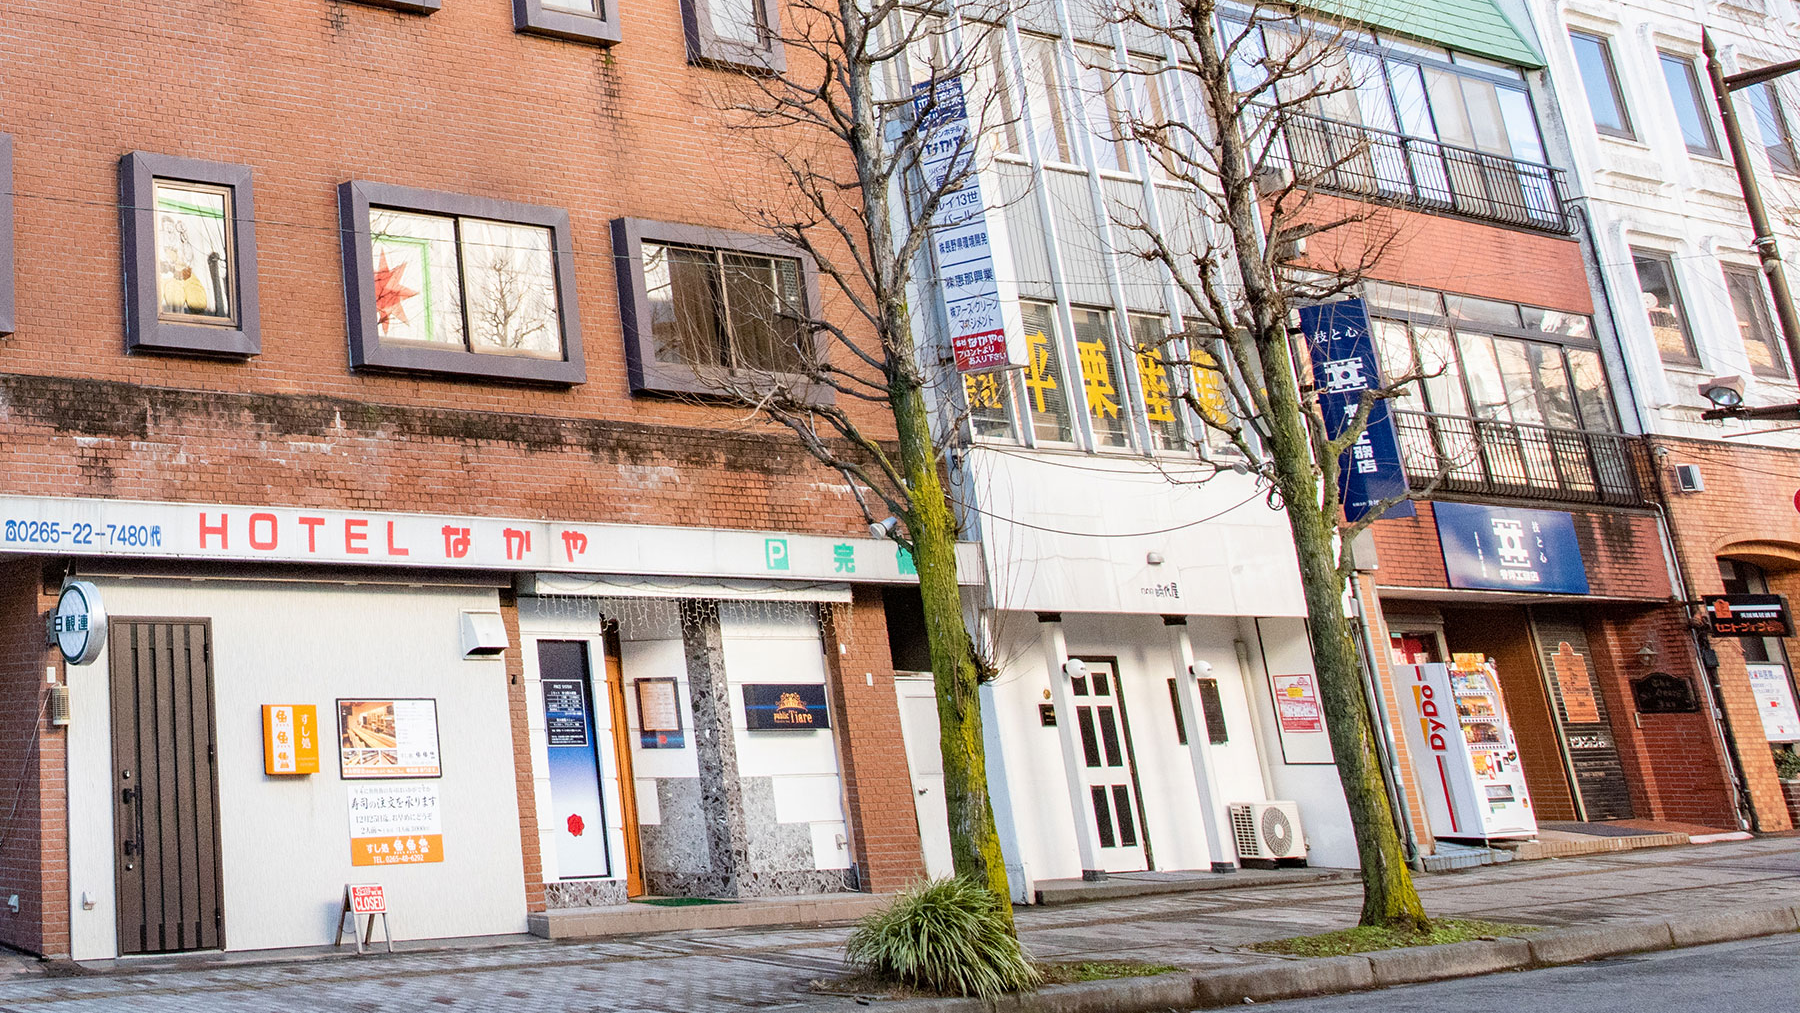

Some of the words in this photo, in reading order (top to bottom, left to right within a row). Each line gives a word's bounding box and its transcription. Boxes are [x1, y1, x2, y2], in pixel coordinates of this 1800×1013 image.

[957, 345, 995, 359] フロントより
[199, 512, 410, 557] HOTEL
[441, 524, 589, 564] なかや
[54, 613, 89, 633] 日観連
[789, 709, 813, 724] Tiare
[1421, 684, 1449, 752] DyDo
[300, 714, 312, 749] すし処
[351, 795, 437, 810] 寿司の注文を承ります
[355, 895, 385, 911] CLOSED
